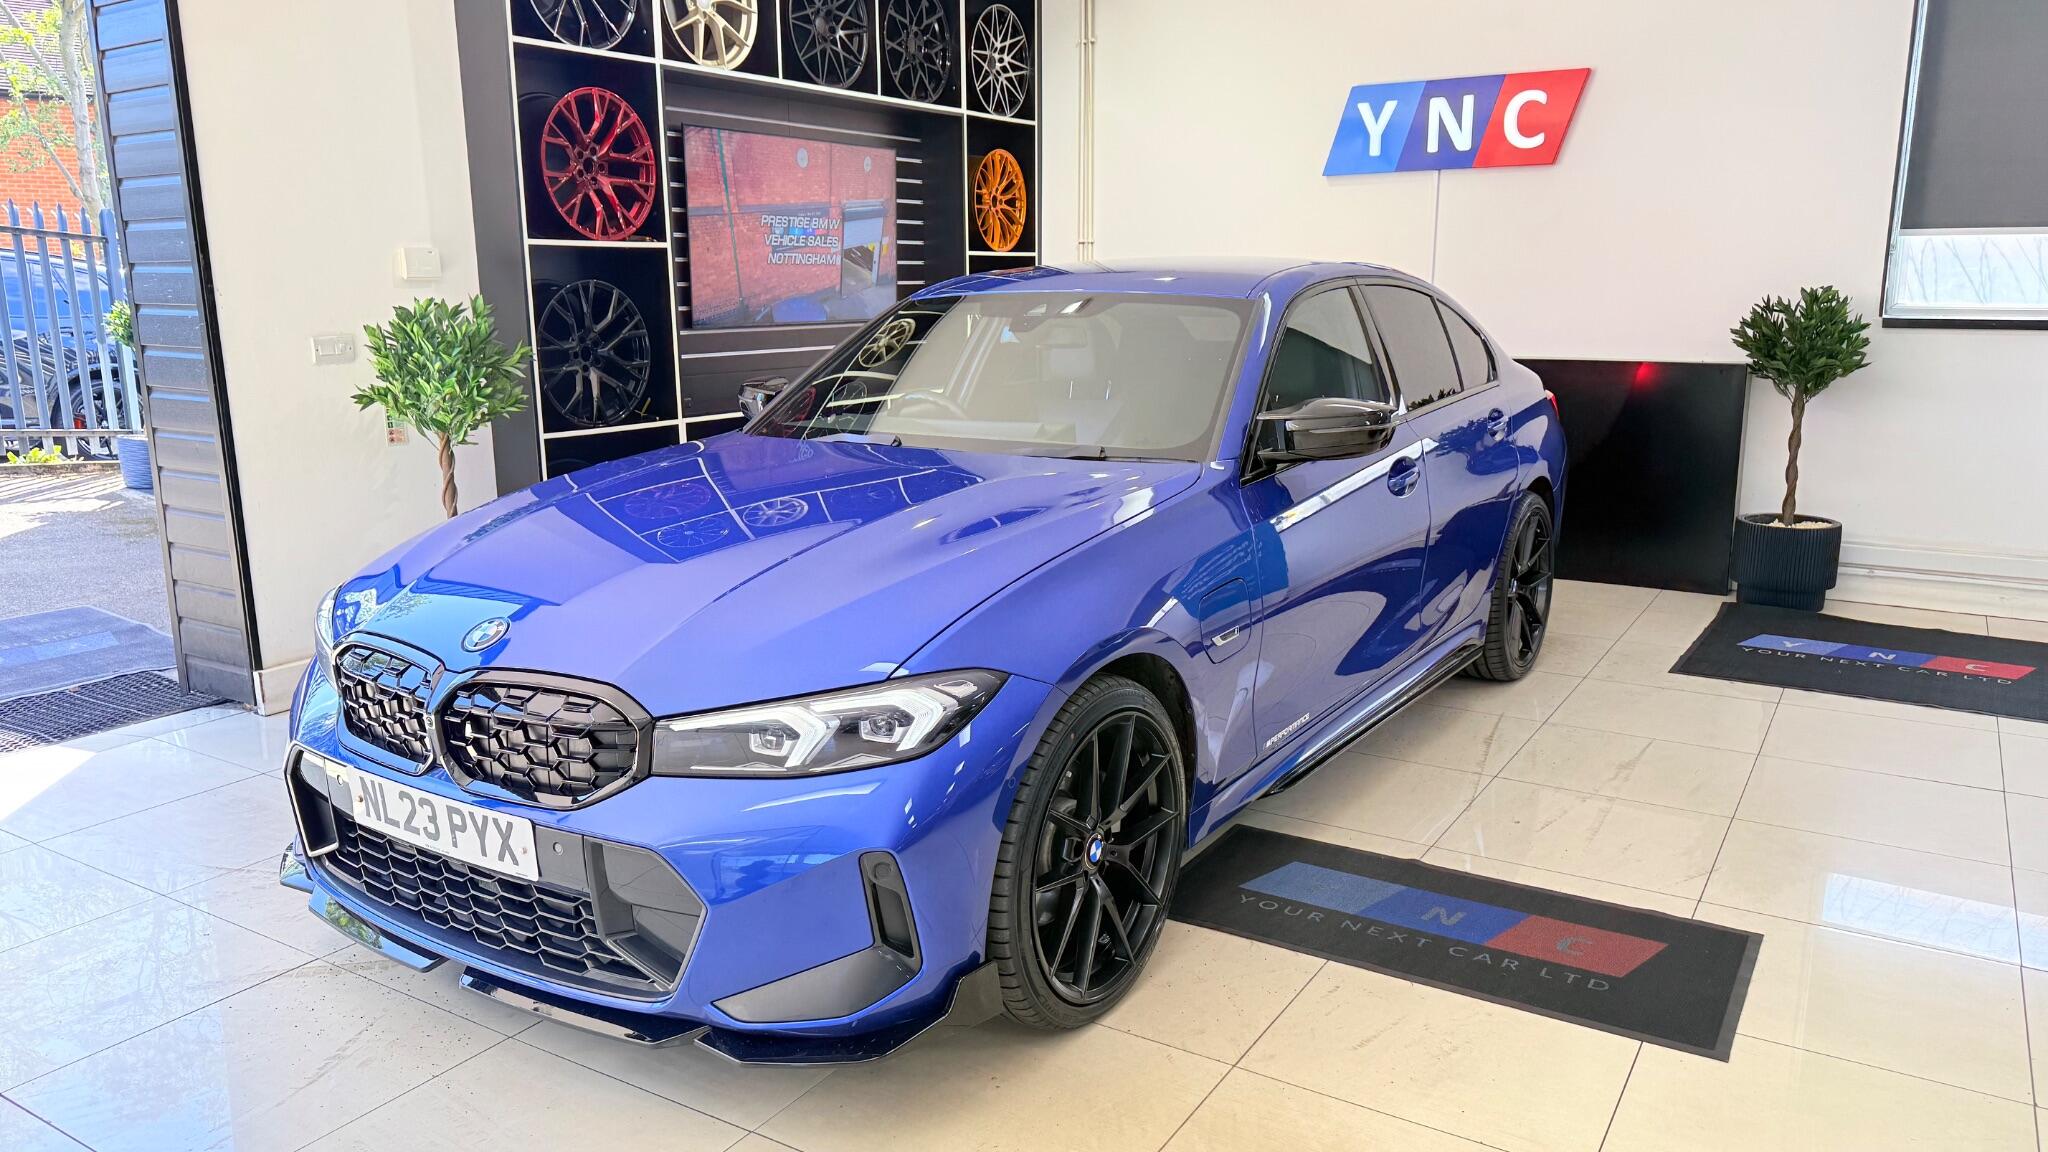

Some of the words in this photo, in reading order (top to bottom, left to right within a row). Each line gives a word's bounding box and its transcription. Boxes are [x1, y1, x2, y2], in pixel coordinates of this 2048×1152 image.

[1357, 89, 1548, 157] YNC
[761, 214, 811, 229] PRESTIGE
[811, 217, 840, 230] BMW
[764, 233, 806, 247] VEHICLE
[807, 235, 839, 247] SALES
[767, 252, 839, 265] NOTTINGHAM
[1741, 646, 1807, 659] YOUR
[1820, 656, 1885, 669] NEXT
[1897, 666, 1949, 678] CAR
[1963, 674, 2013, 686] LTD
[359, 776, 441, 842] NL23
[446, 804, 519, 867] PYX
[1239, 893, 1325, 923] YOUR
[1340, 919, 1433, 948] NEXT
[1448, 946, 1520, 971] CAR
[1539, 966, 1610, 991] LTD
